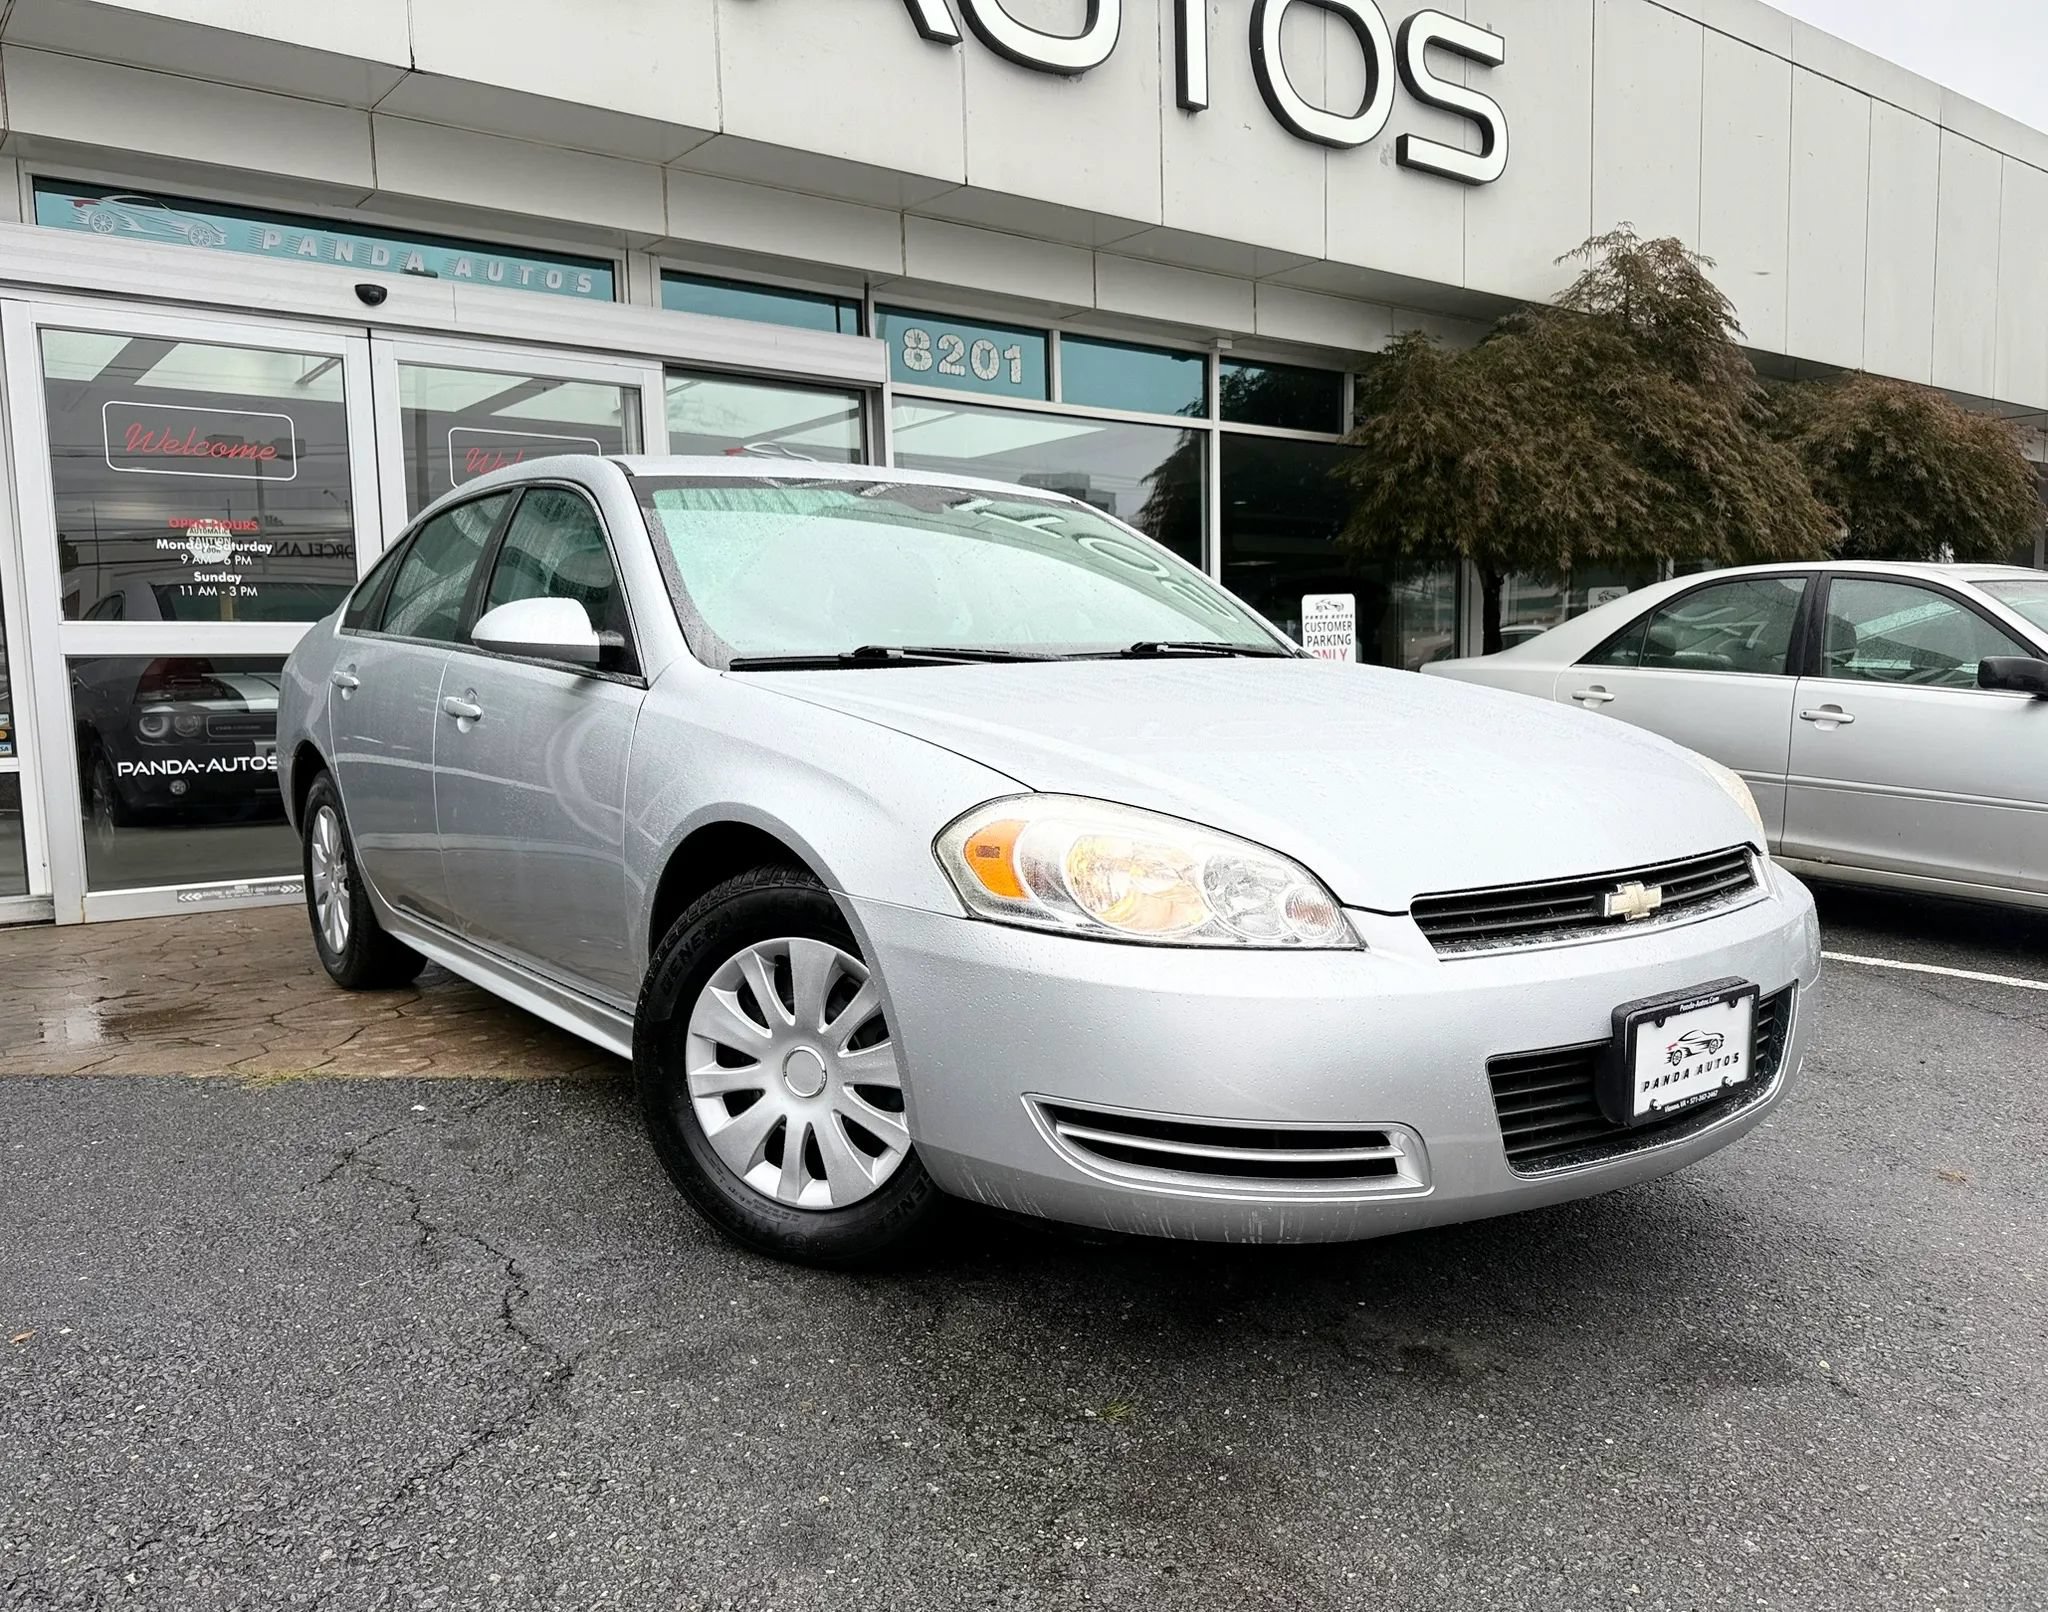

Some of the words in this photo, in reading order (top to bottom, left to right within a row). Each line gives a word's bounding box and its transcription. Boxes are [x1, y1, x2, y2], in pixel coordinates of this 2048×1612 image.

[258, 228, 426, 272] PANDA
[453, 256, 592, 293] AUTOS
[902, 327, 1022, 385] 8201
[124, 422, 278, 461] Welcome
[168, 518, 209, 530] OPEN
[212, 520, 258, 532] HOURS
[180, 554, 188, 564] 9
[192, 554, 212, 565] AM
[223, 554, 231, 566] 6
[235, 554, 252, 566] PM
[193, 571, 242, 584] Sunday
[180, 585, 192, 596] 11
[198, 585, 217, 597] AM
[229, 586, 236, 597] 3
[240, 586, 258, 597] PM
[1304, 620, 1353, 633] CUSTOMER
[1306, 633, 1352, 647] PARKING
[117, 756, 278, 777] PANDA-AUTOS
[1641, 1068, 1690, 1093] PANDA
[1695, 1052, 1739, 1076] AUTOS
